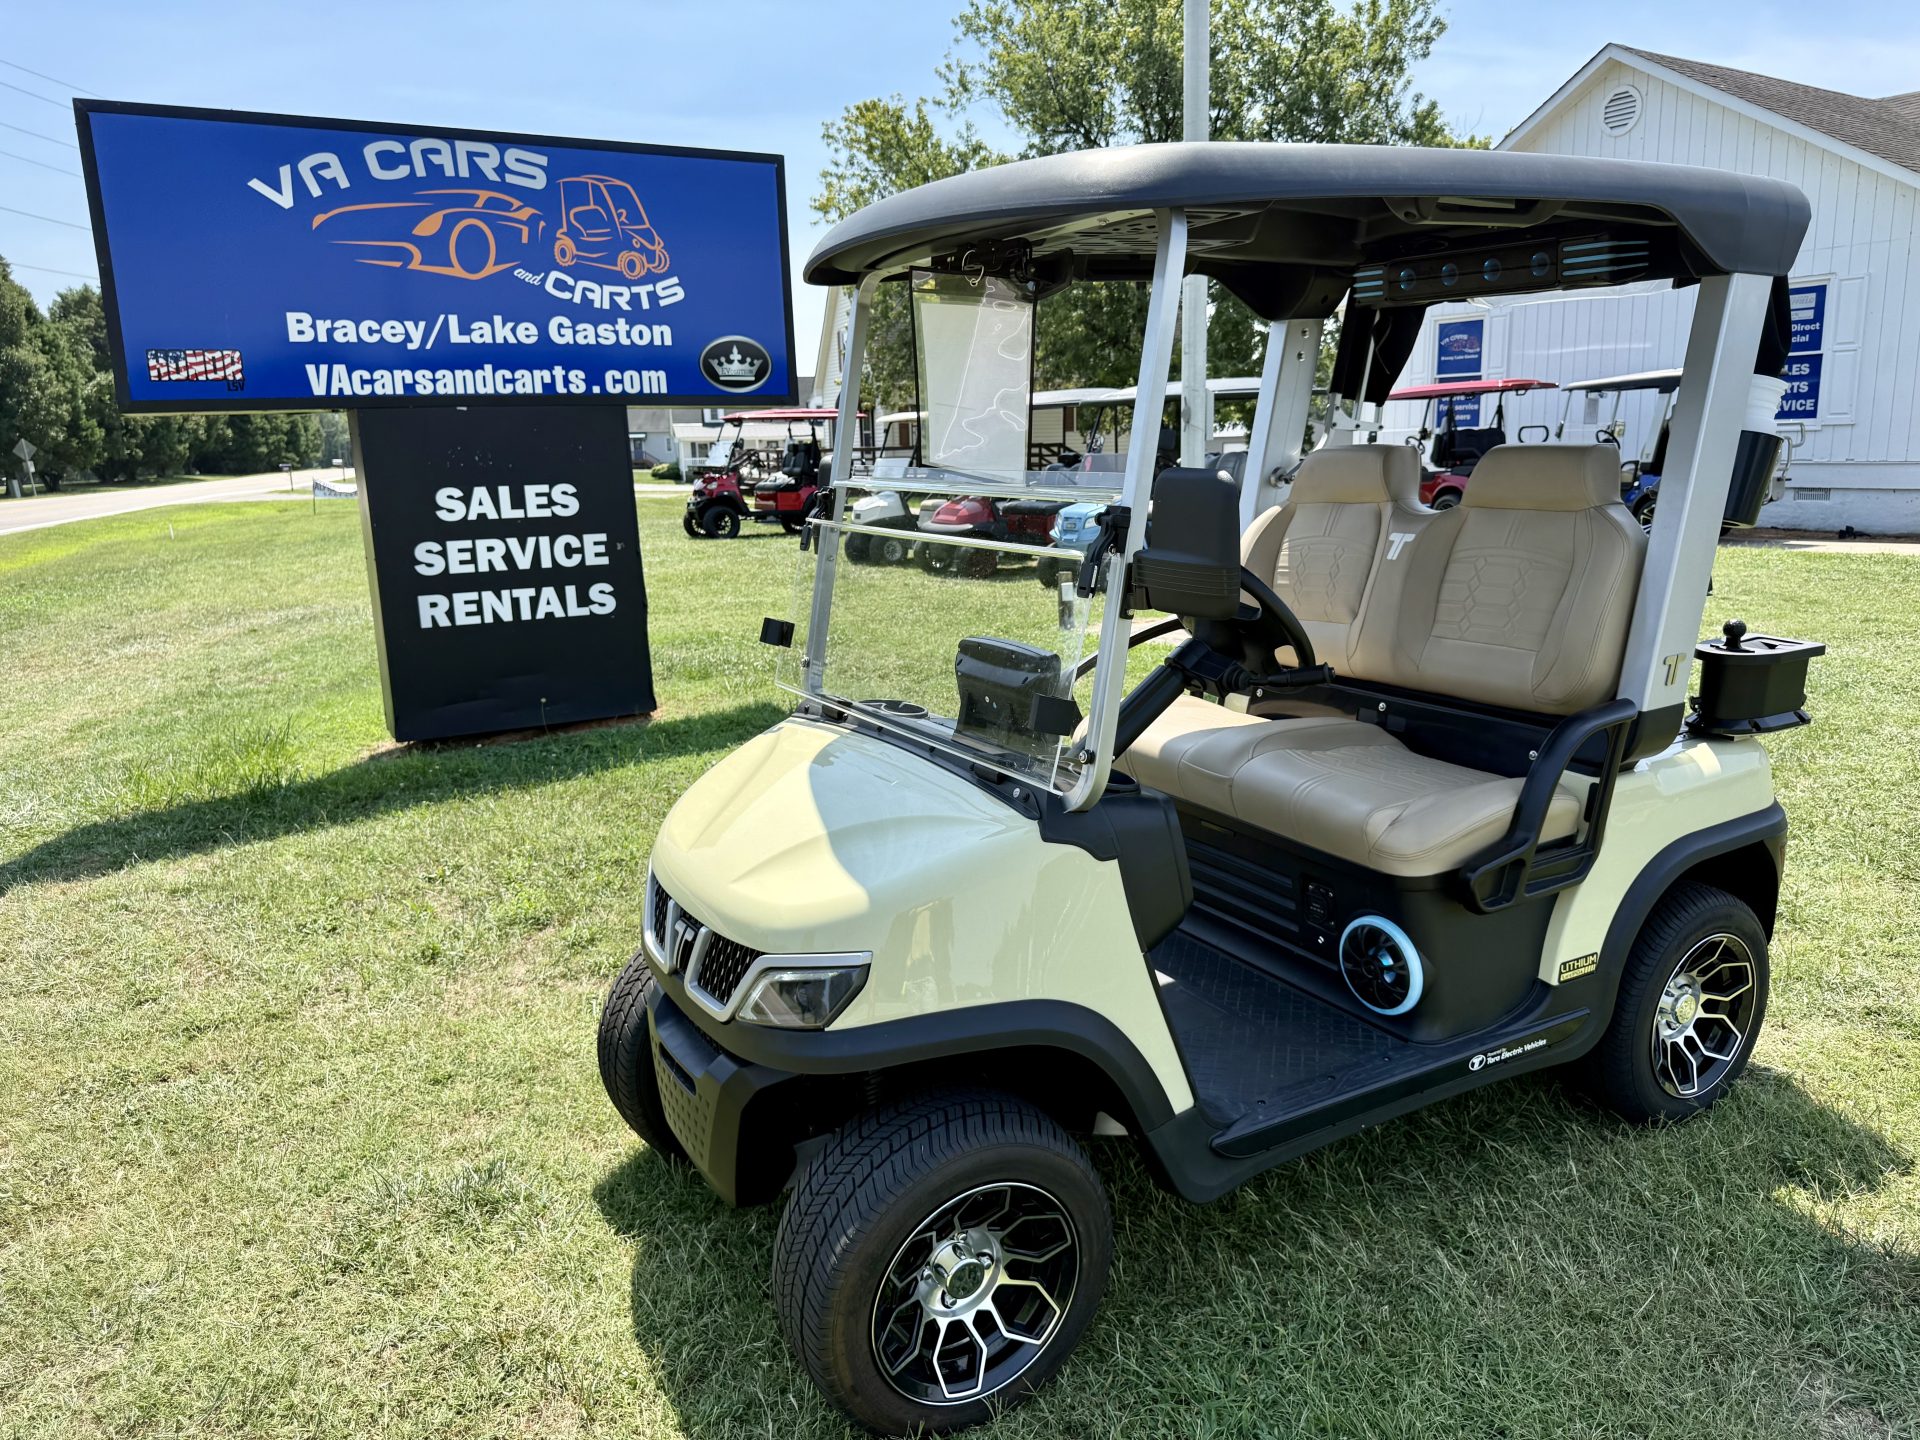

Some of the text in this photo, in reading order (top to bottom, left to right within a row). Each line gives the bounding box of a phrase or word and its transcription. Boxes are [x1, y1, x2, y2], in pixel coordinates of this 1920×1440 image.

[247, 138, 548, 210] VA CARS
[513, 268, 685, 311] and CARTS
[286, 311, 673, 350] Bracey/Lake Gaston
[1791, 334, 1809, 342] cial
[146, 349, 244, 381] HONOR
[1783, 363, 1810, 376] LES
[435, 483, 580, 522] SALES
[413, 533, 610, 576] SERVICE
[417, 582, 617, 629] RENTALS
[1561, 954, 1598, 973] LITHIUM
[1501, 1046, 1524, 1060] Electric
[1523, 1039, 1547, 1052] Vehicles
